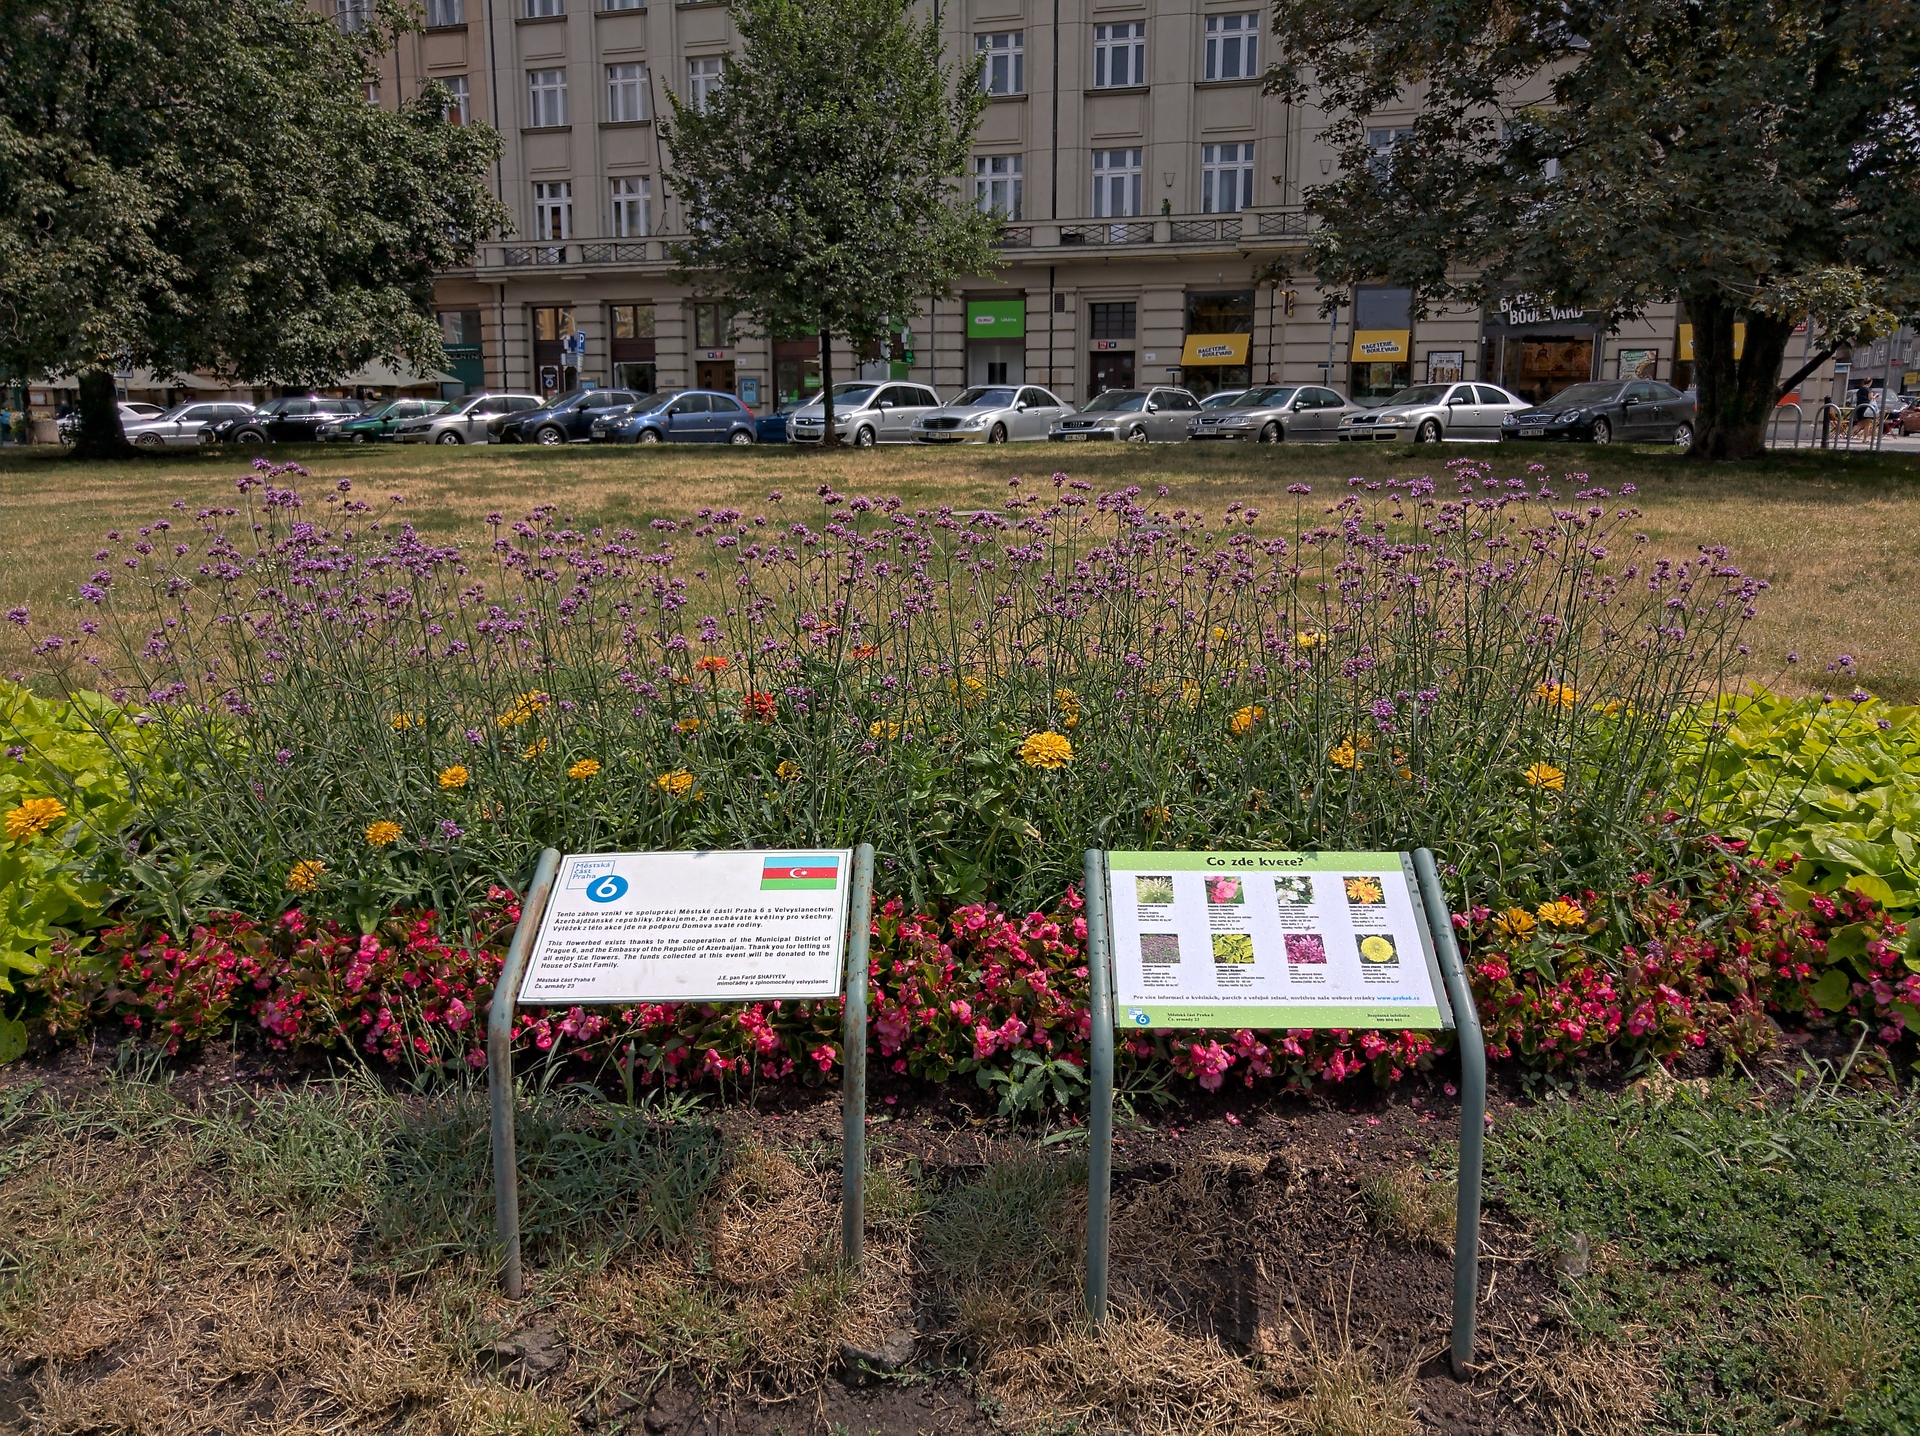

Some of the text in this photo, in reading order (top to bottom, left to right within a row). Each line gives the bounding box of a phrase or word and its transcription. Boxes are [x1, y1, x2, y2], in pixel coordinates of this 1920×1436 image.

[580, 334, 584, 347] P
[1198, 345, 1227, 354] BAGETERIE
[1361, 341, 1392, 350] BAGETERIE
[1206, 857, 1304, 866] Co zde kvete?
[596, 876, 618, 898] 6
[636, 909, 676, 917] spolupráci
[775, 907, 833, 915] Velvyslanectvím
[615, 917, 654, 925] republiky.
[801, 914, 833, 922] všechny.
[1139, 1015, 1146, 1024] 6
